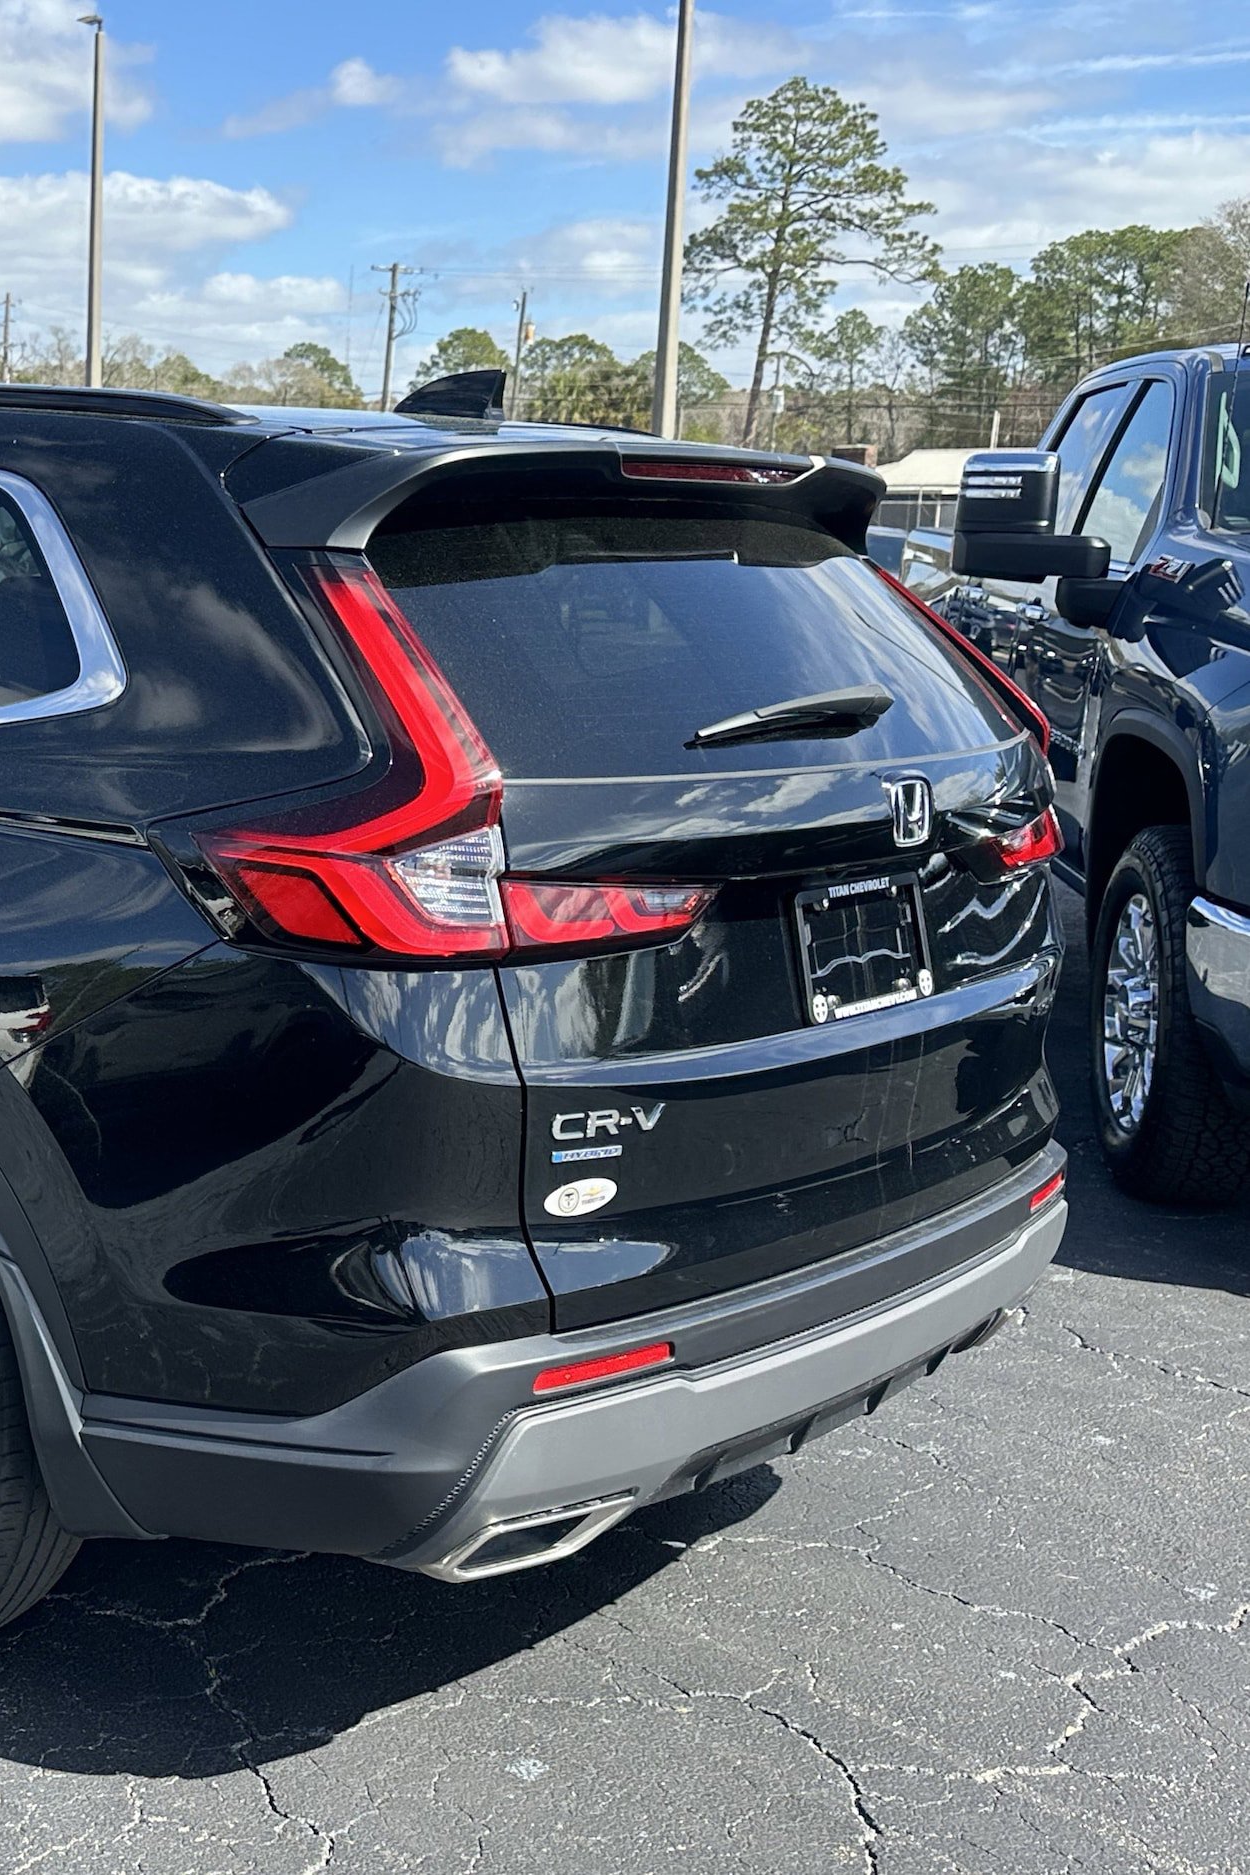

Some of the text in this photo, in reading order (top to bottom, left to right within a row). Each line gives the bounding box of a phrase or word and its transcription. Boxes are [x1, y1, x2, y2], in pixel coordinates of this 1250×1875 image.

[828, 877, 890, 898] TITAN CHEVROLET
[551, 1102, 667, 1141] CR-V
[563, 1147, 620, 1160] HYBRID
